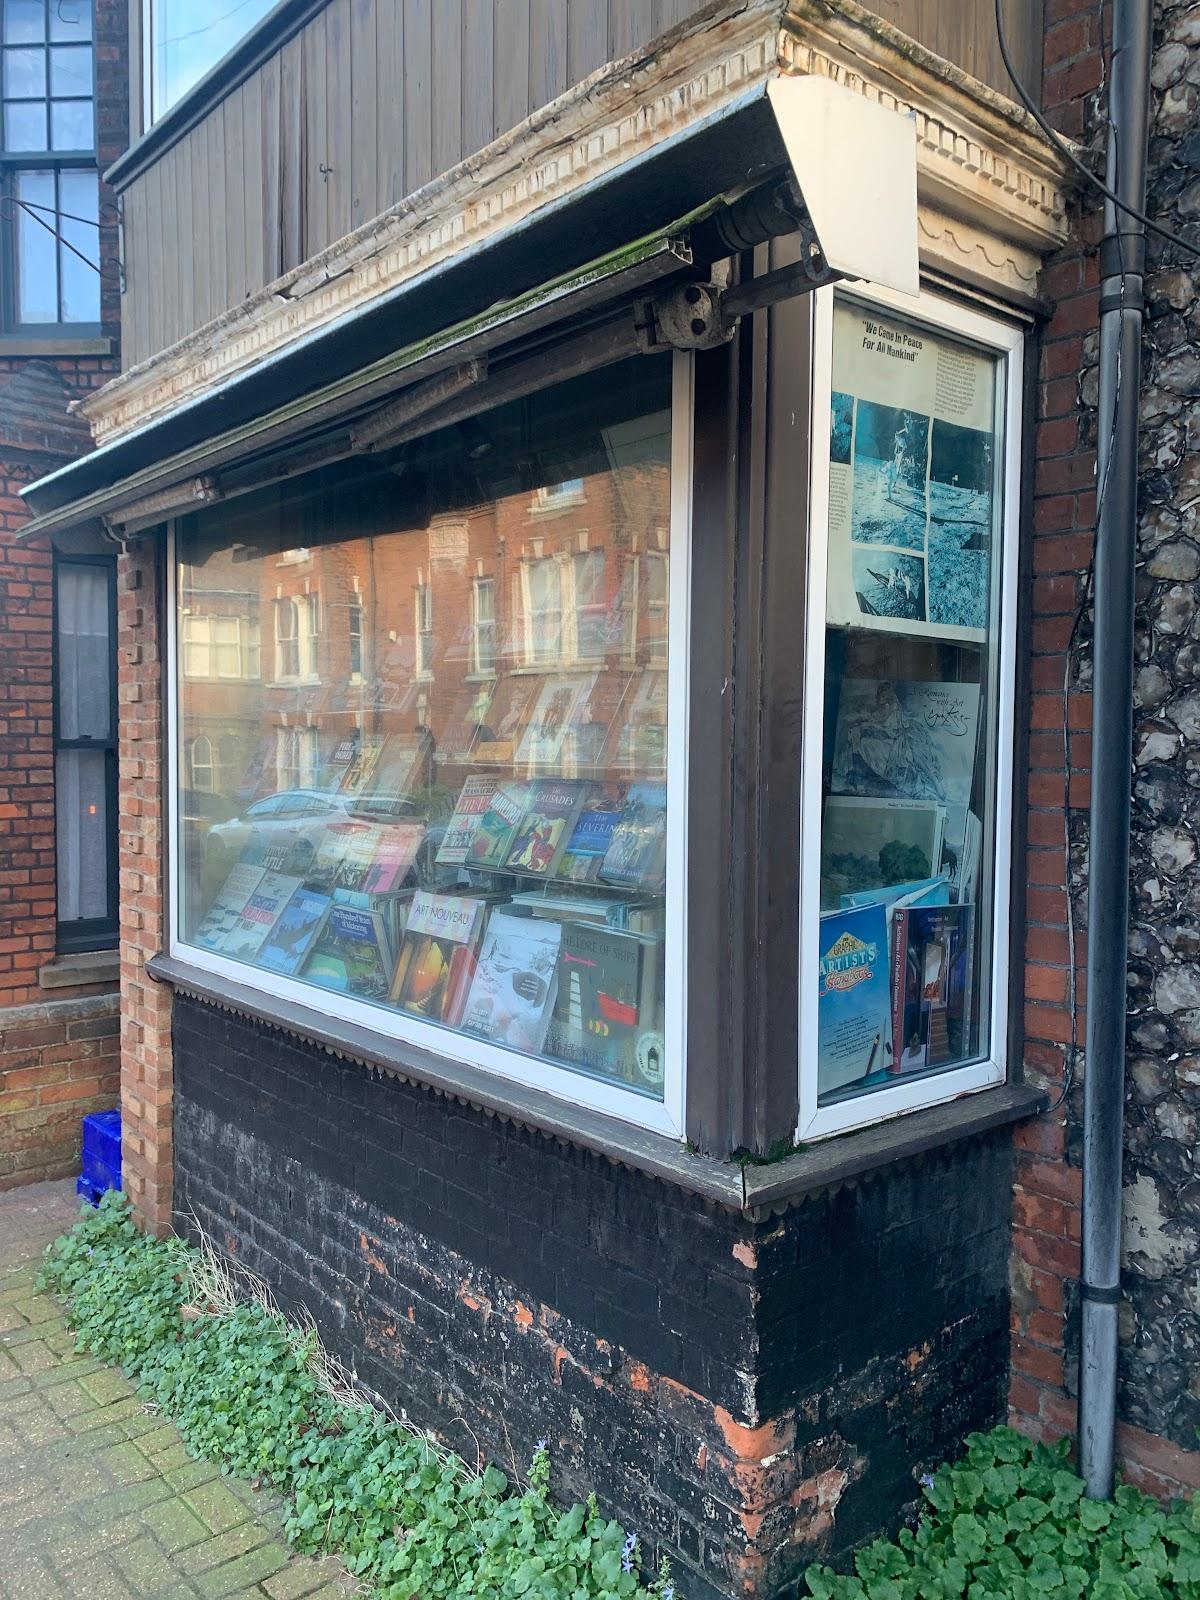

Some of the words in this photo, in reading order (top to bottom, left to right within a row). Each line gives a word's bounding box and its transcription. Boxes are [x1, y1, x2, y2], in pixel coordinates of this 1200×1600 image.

[862, 337, 875, 350] For
[876, 341, 886, 354] All
[878, 326, 894, 341] Came
[894, 332, 902, 344] In
[903, 334, 923, 350] Peace
[535, 790, 575, 806] CRUSADES
[594, 814, 608, 822] TIM
[414, 904, 429, 917] ART
[430, 906, 471, 925] NOUVEAU
